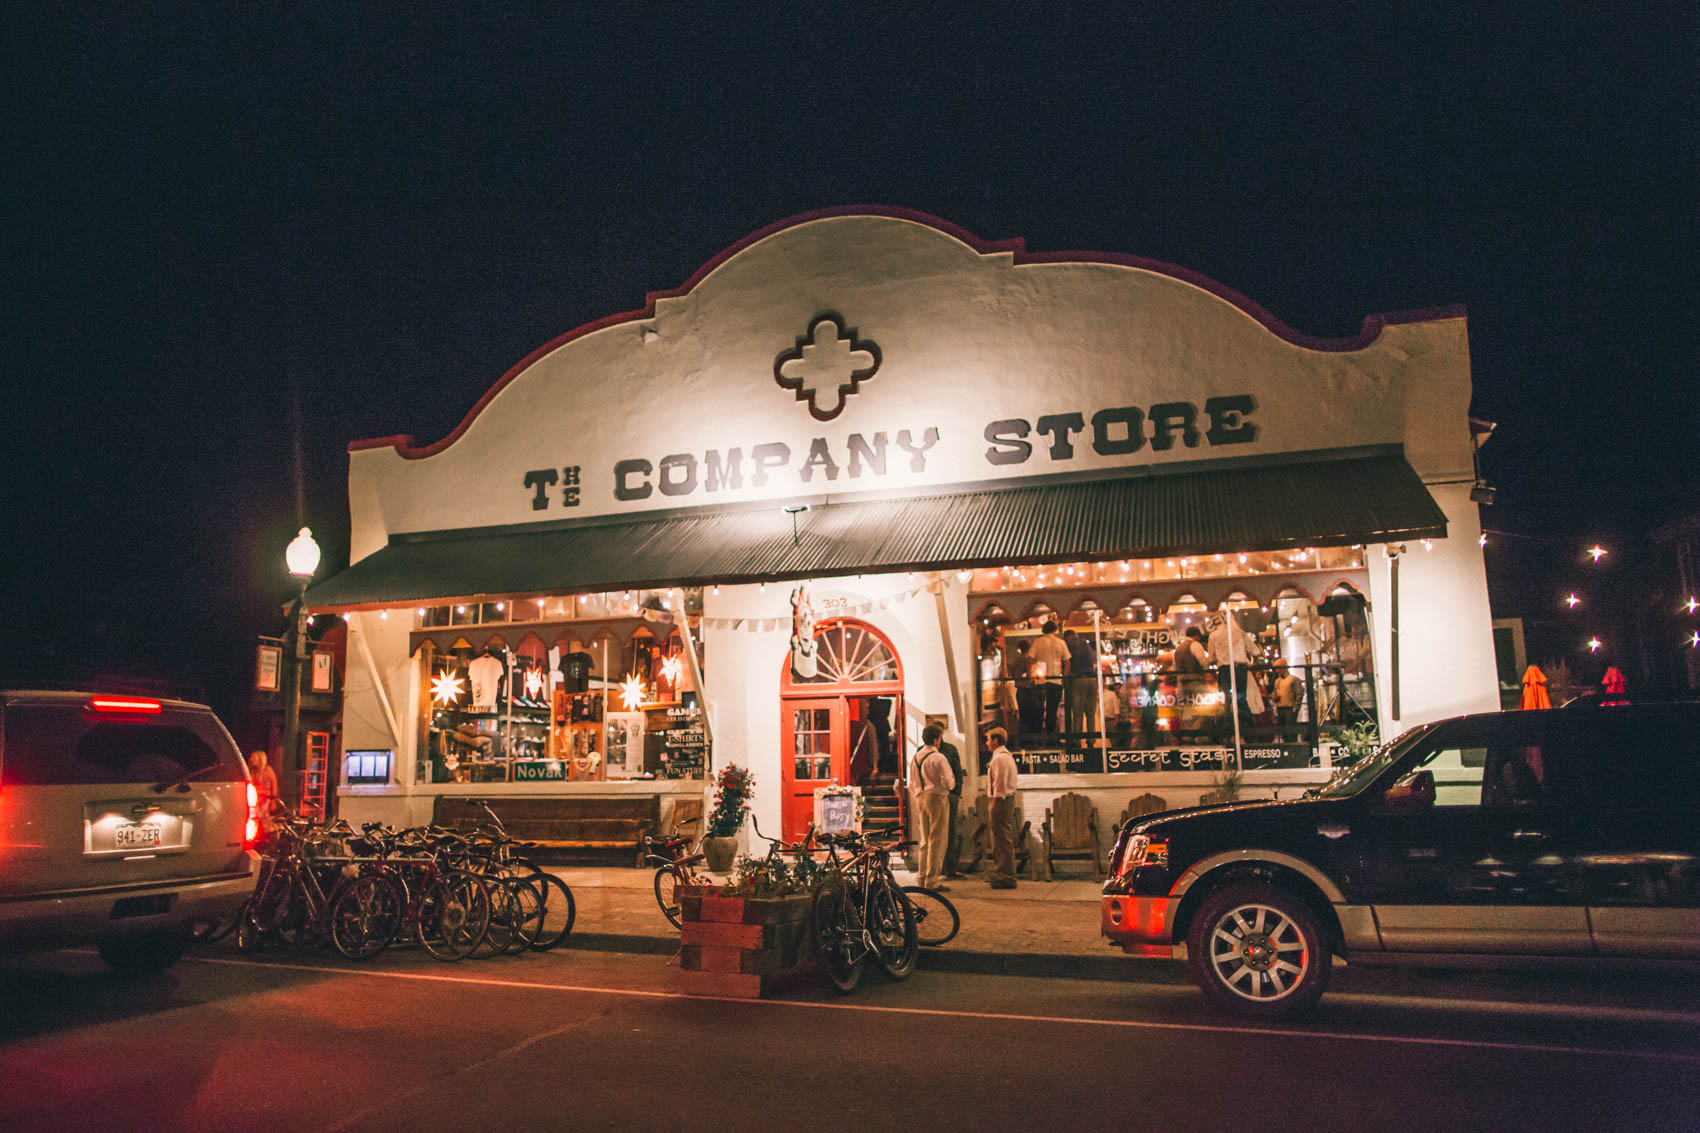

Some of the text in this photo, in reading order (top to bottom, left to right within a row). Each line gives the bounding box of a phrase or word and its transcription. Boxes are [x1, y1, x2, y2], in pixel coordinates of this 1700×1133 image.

[614, 426, 940, 501] COMPANY
[984, 394, 1257, 466] STORE
[822, 597, 848, 609] 303
[1022, 754, 1085, 764] PASTA SALAD BAR
[1244, 749, 1281, 759] ESPRESSO
